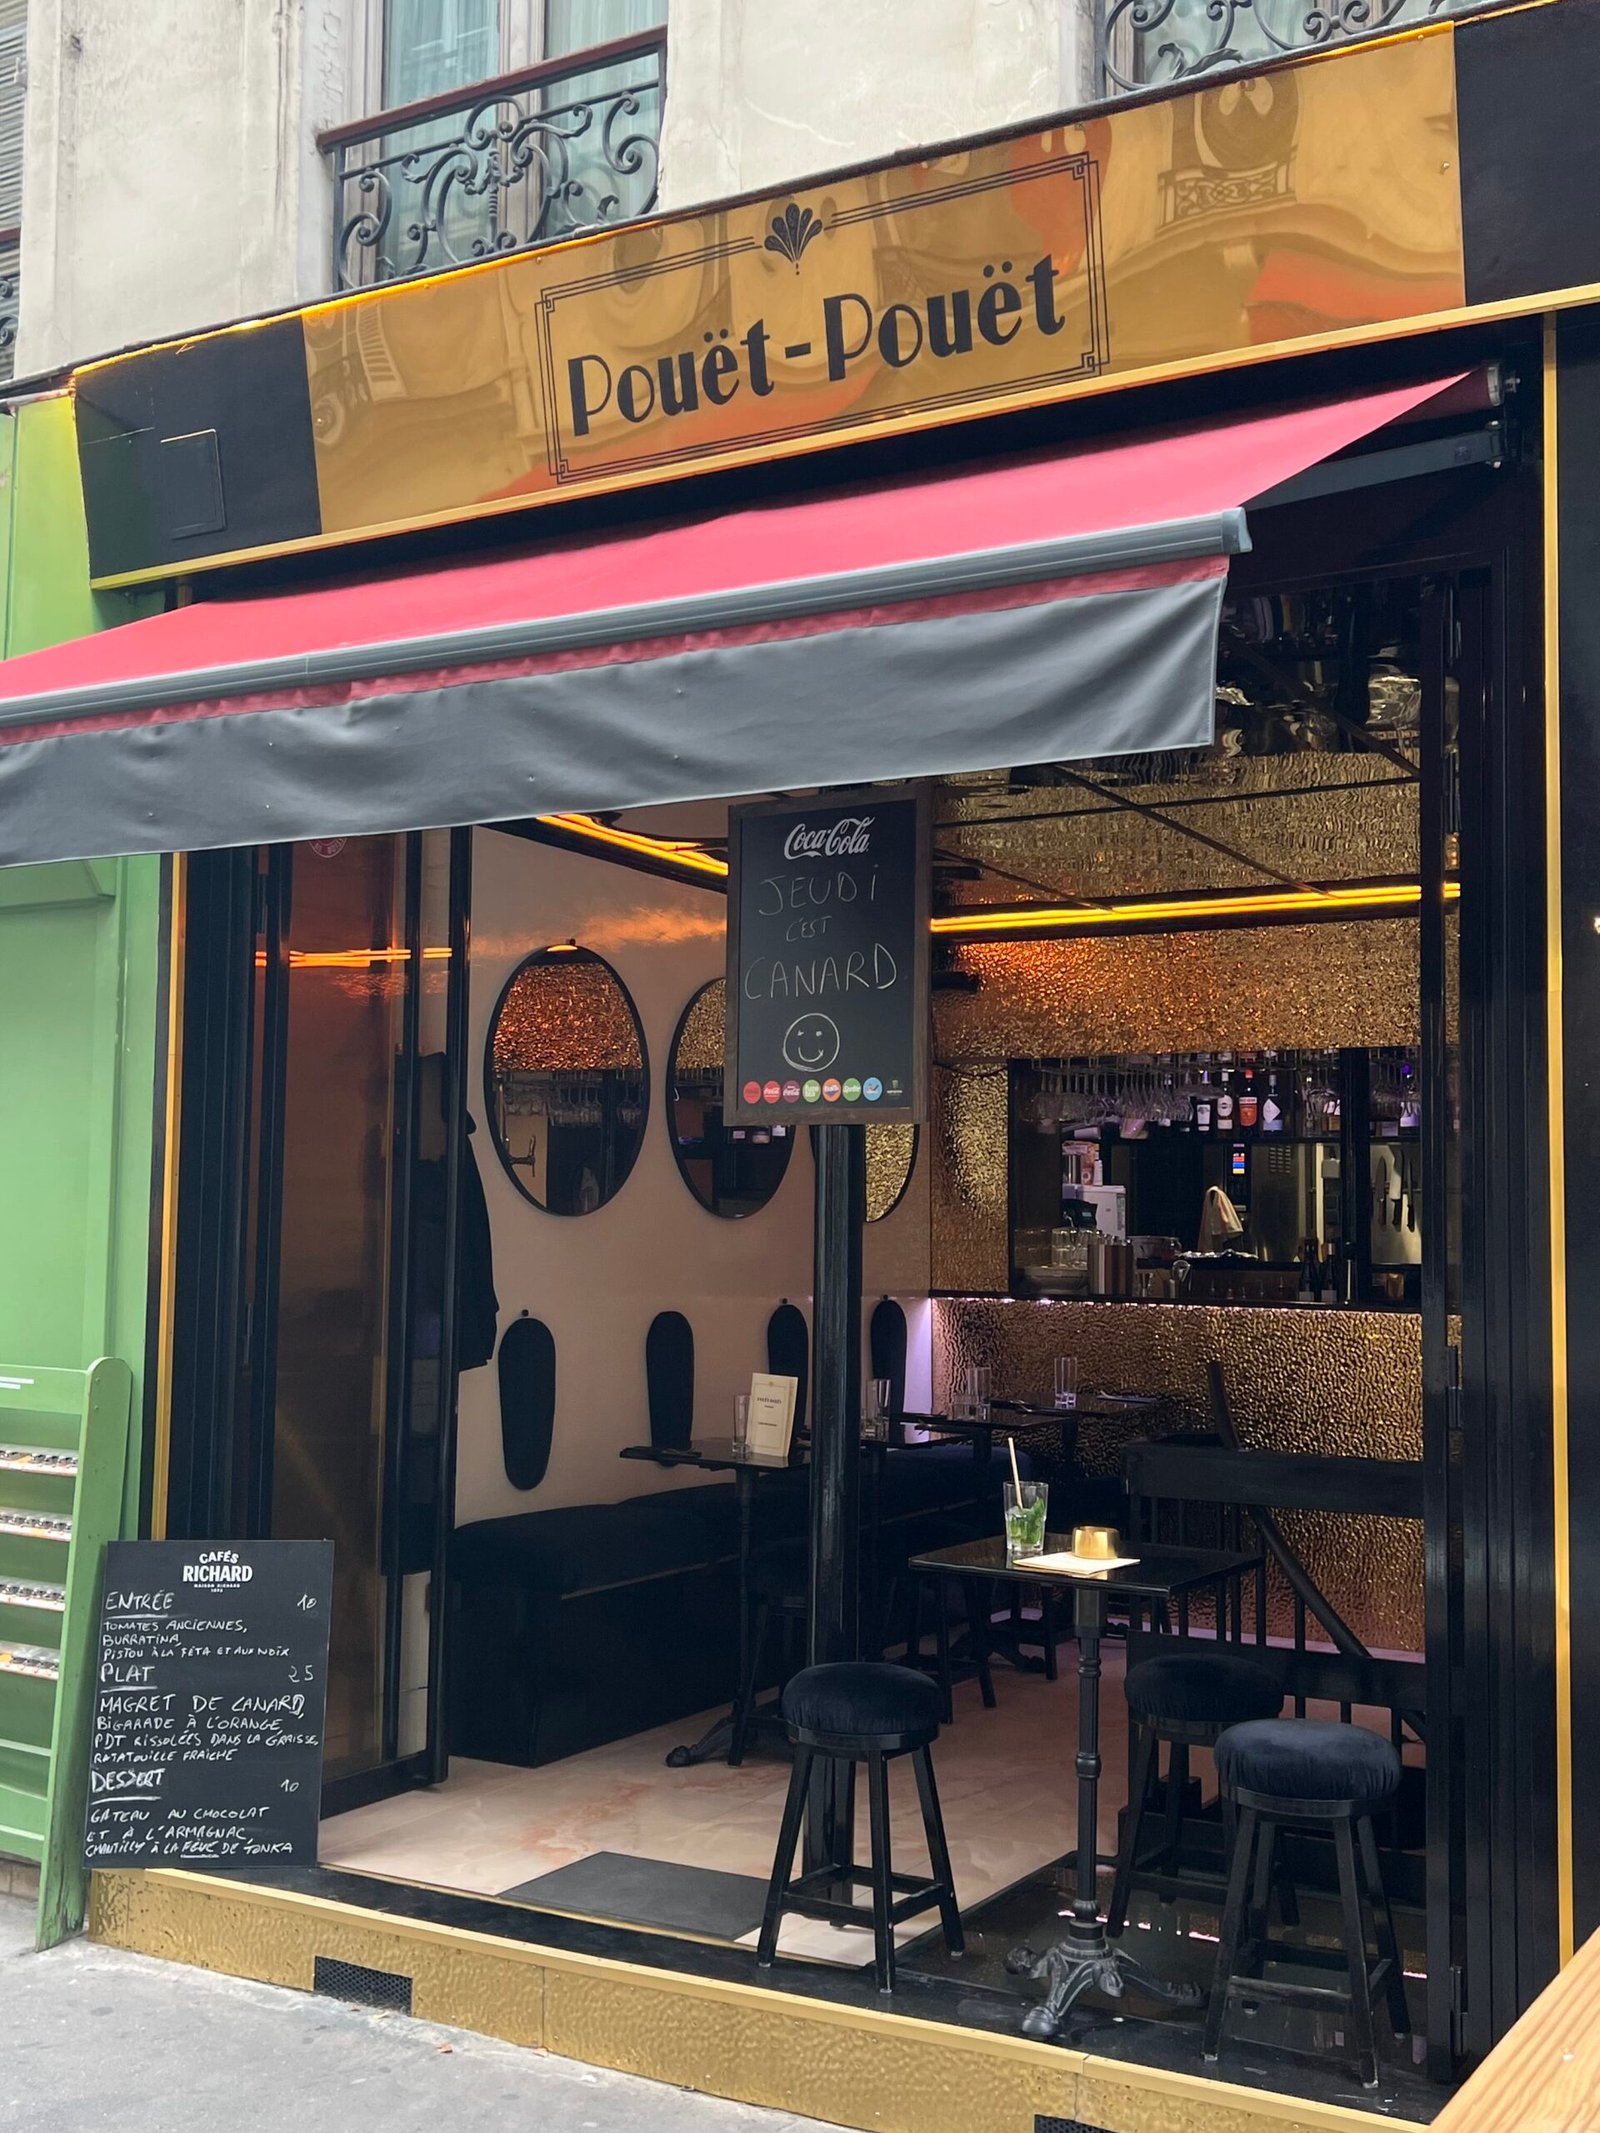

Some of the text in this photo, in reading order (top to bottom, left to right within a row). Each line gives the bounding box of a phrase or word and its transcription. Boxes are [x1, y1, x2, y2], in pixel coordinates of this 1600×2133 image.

[567, 253, 1066, 437] Pouët-Pouët
[784, 816, 876, 860] Coca-Cola
[786, 915, 833, 942] C'EST
[744, 943, 897, 1000] CANARD
[199, 1550, 239, 1564] CAFÉS
[183, 1565, 253, 1582] RICHARD
[105, 1589, 318, 1611] ENTRÉE 10
[161, 1649, 174, 1658] LA
[217, 1646, 231, 1655] ET
[233, 1645, 255, 1655] AUX
[100, 1662, 314, 1683] PLAT 25
[100, 1693, 176, 1714] MAGRET
[192, 1694, 224, 1713] DE
[186, 1713, 197, 1729] À
[95, 1733, 127, 1750] PDT
[210, 1733, 242, 1747] DANS
[246, 1733, 261, 1744] LA
[92, 1768, 300, 1793] DESSERT 10
[167, 1808, 187, 1820] AU
[193, 1806, 270, 1820] CHOCOLAT
[87, 1829, 110, 1843] ET
[163, 1842, 179, 1855] LA
[221, 1842, 240, 1855] DE
[243, 1841, 293, 1855] TONKA
